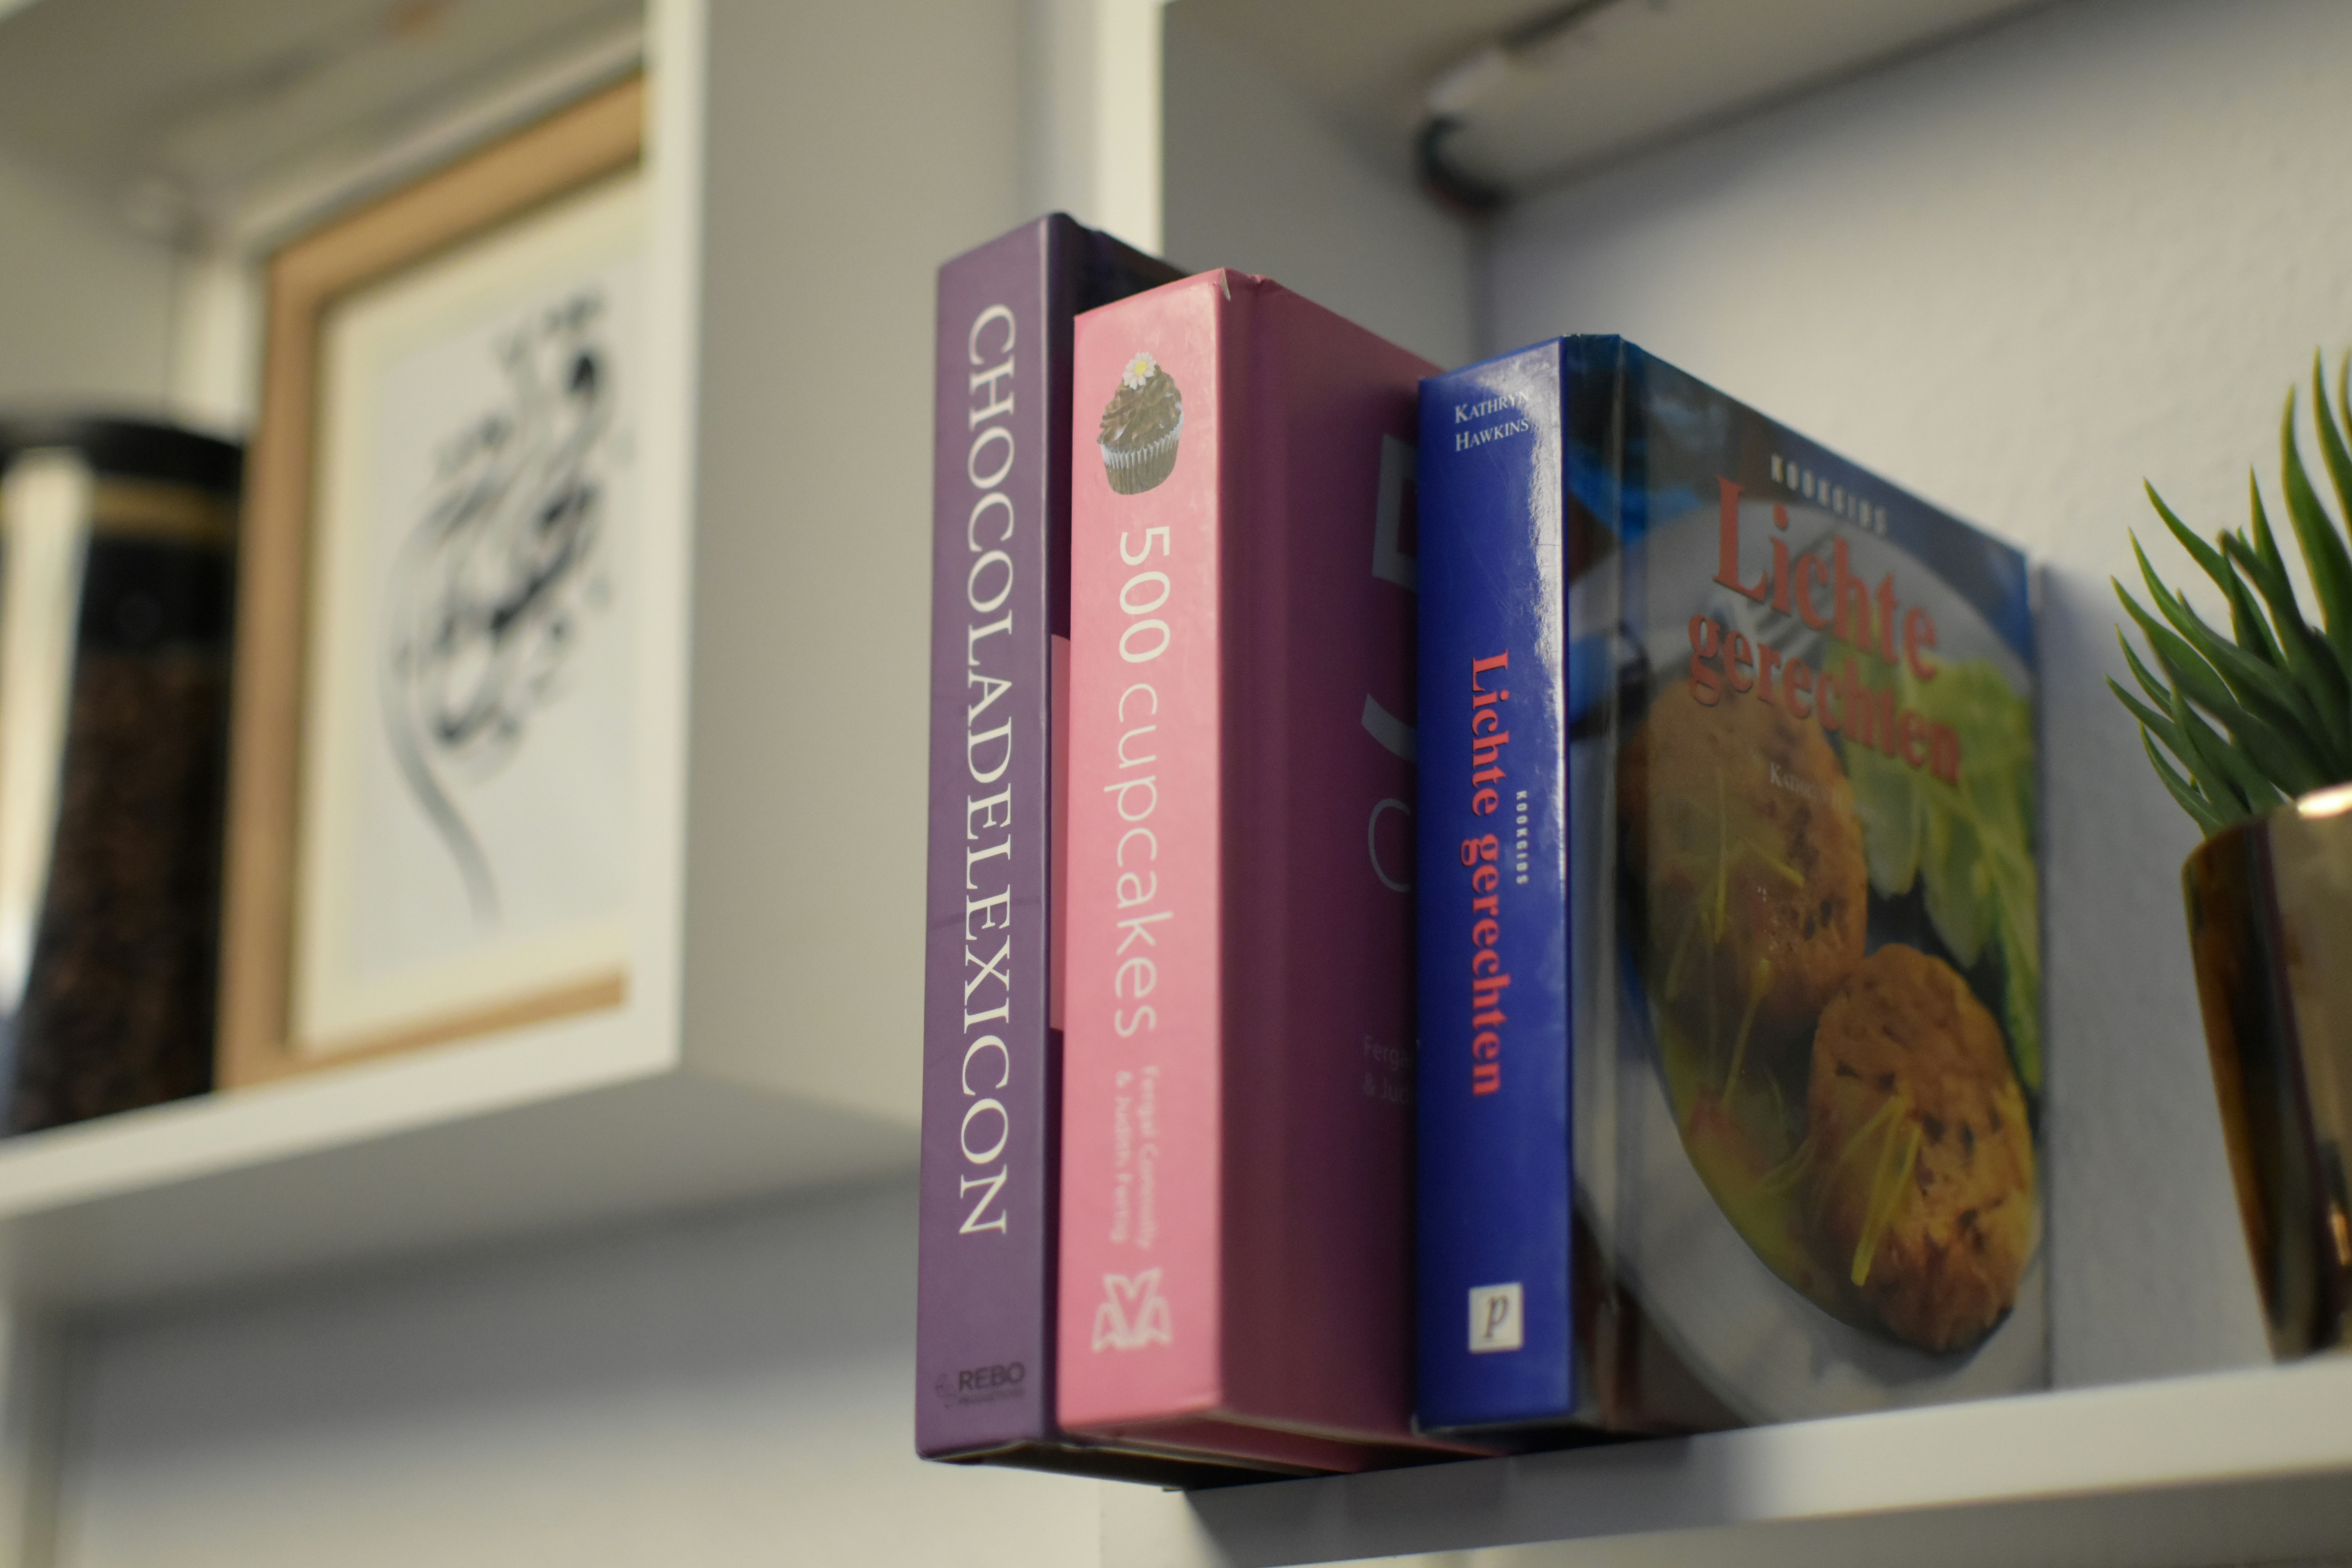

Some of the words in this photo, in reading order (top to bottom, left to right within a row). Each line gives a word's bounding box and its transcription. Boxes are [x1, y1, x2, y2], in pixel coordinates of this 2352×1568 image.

[1454, 391, 1529, 424] KATHRYN
[1455, 417, 1531, 452] HAWKINS
[1118, 525, 1171, 664] 500
[1713, 474, 1938, 681] Lichte
[958, 303, 1016, 1236] CHOCOLADELEXICON
[1470, 648, 1510, 816] Lichte
[1688, 613, 1961, 785] gerechten
[1103, 682, 1175, 1039] cupcakes
[1516, 790, 1529, 885] KOOKGIDS
[1461, 832, 1512, 1098] gerechten
[958, 1361, 1026, 1391] REBO
